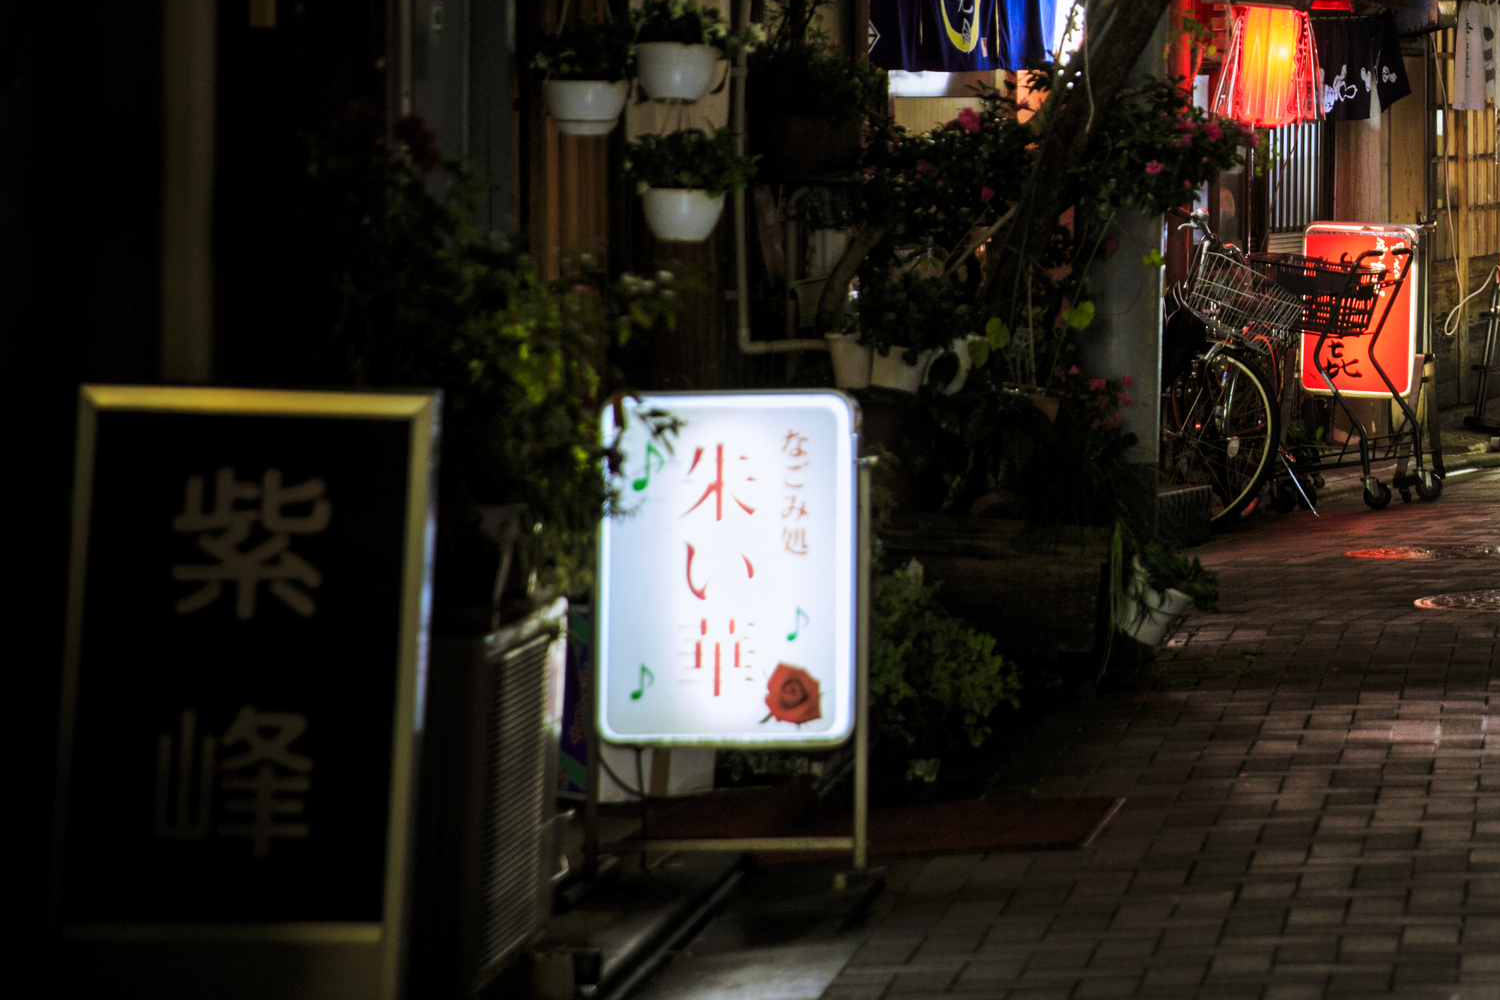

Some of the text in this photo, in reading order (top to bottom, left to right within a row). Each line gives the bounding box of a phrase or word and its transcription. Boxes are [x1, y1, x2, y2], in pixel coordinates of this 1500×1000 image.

[678, 442, 758, 697] 朱い華
[780, 428, 812, 557] なごみ処
[150, 463, 335, 862] 紫峰
